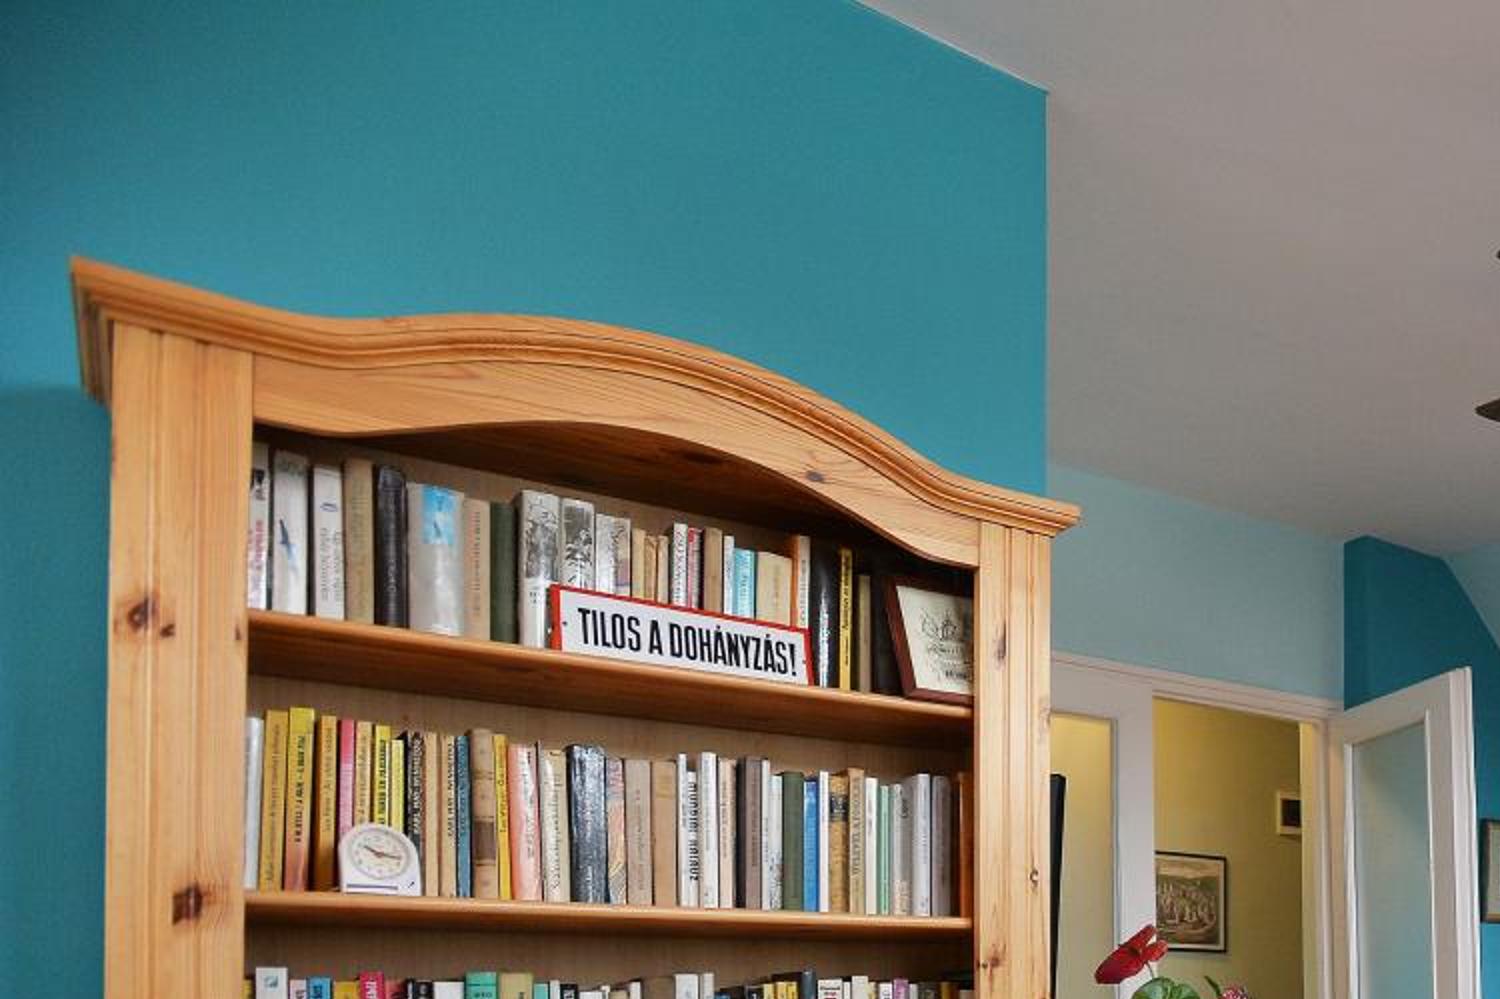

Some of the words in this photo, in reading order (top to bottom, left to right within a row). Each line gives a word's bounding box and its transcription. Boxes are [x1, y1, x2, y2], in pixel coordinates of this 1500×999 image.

[577, 607, 641, 653] TILOS
[649, 619, 665, 657] A
[669, 624, 798, 678] DOHÁNYZÁS!
